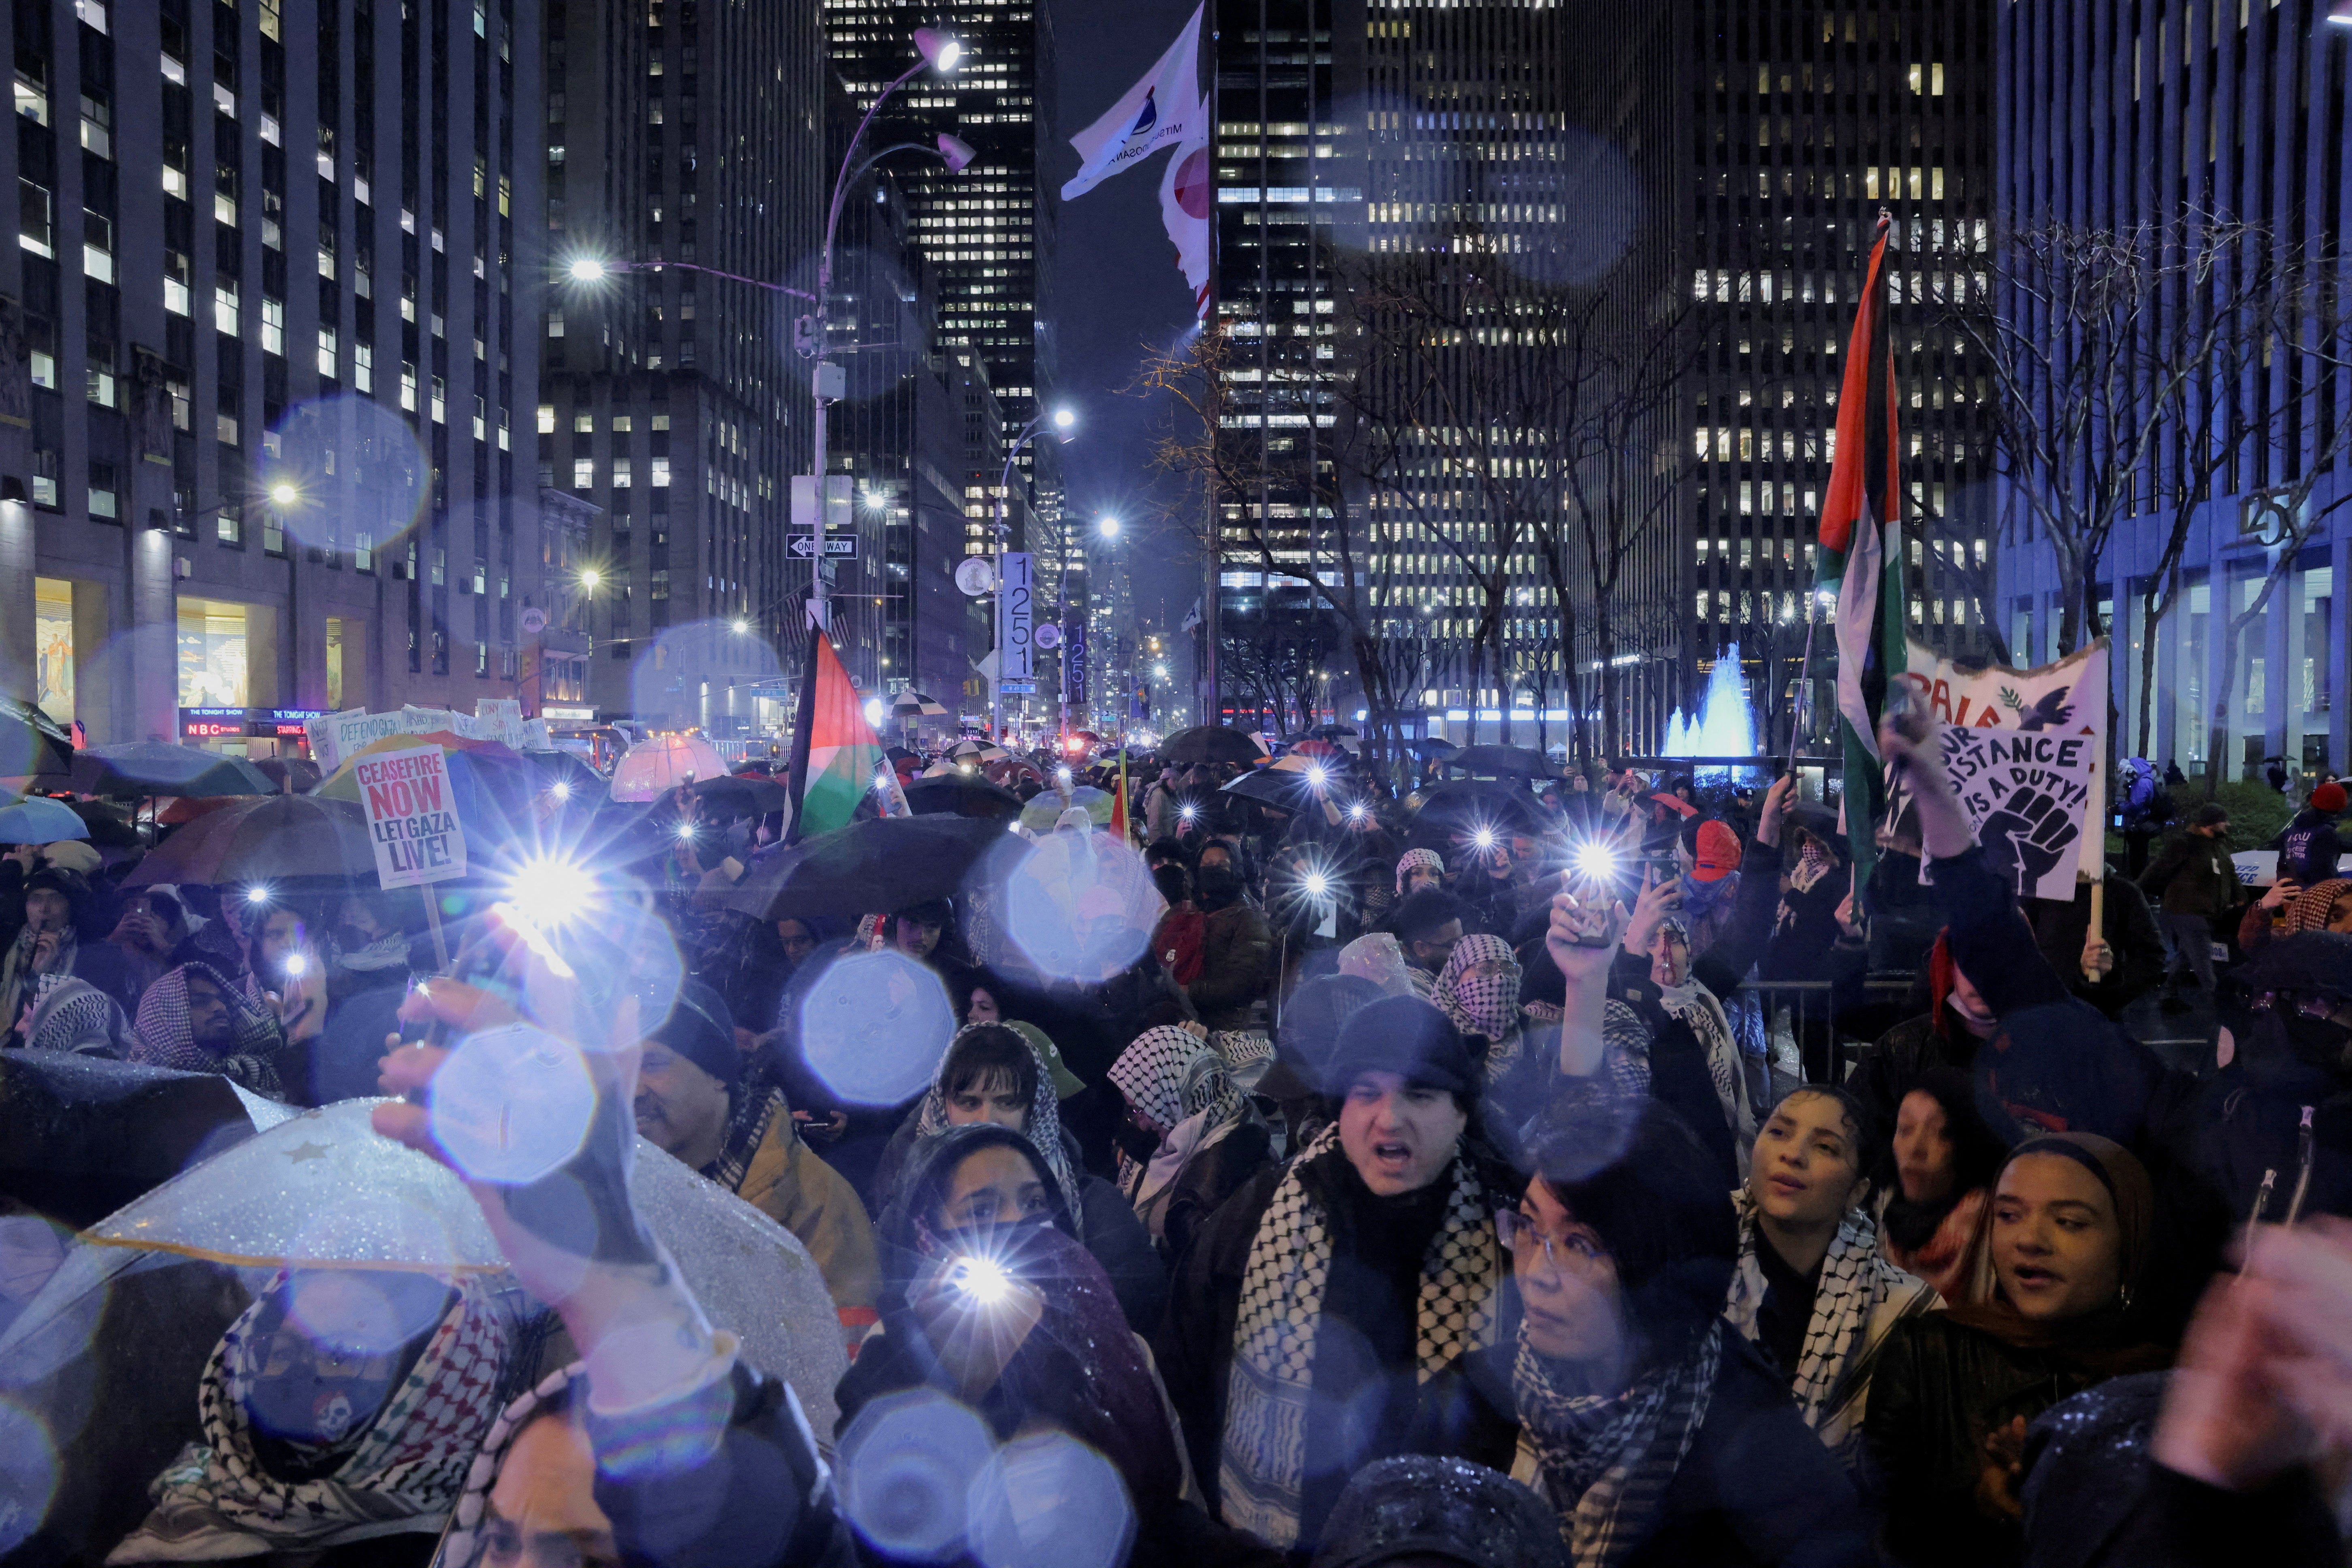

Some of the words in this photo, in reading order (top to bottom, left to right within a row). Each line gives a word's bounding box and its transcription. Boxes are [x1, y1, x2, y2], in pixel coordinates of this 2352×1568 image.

[827, 542, 848, 551] WAY
[1011, 557, 1029, 674] 1251
[1072, 624, 1084, 702] 1251
[188, 724, 219, 735] NBC
[273, 710, 282, 718] THE
[283, 711, 305, 719] TONIGHT
[277, 726, 301, 734] STARRING
[341, 719, 377, 742] DEFEND
[358, 753, 442, 785] CEASEFIRE
[368, 775, 442, 820] NOW
[1964, 792, 1991, 816] IS
[1988, 776, 2010, 800] A
[2010, 767, 2087, 809] DUTY!
[374, 818, 404, 843] LET
[407, 812, 456, 837] GAZA
[388, 837, 452, 872] LIVE!
